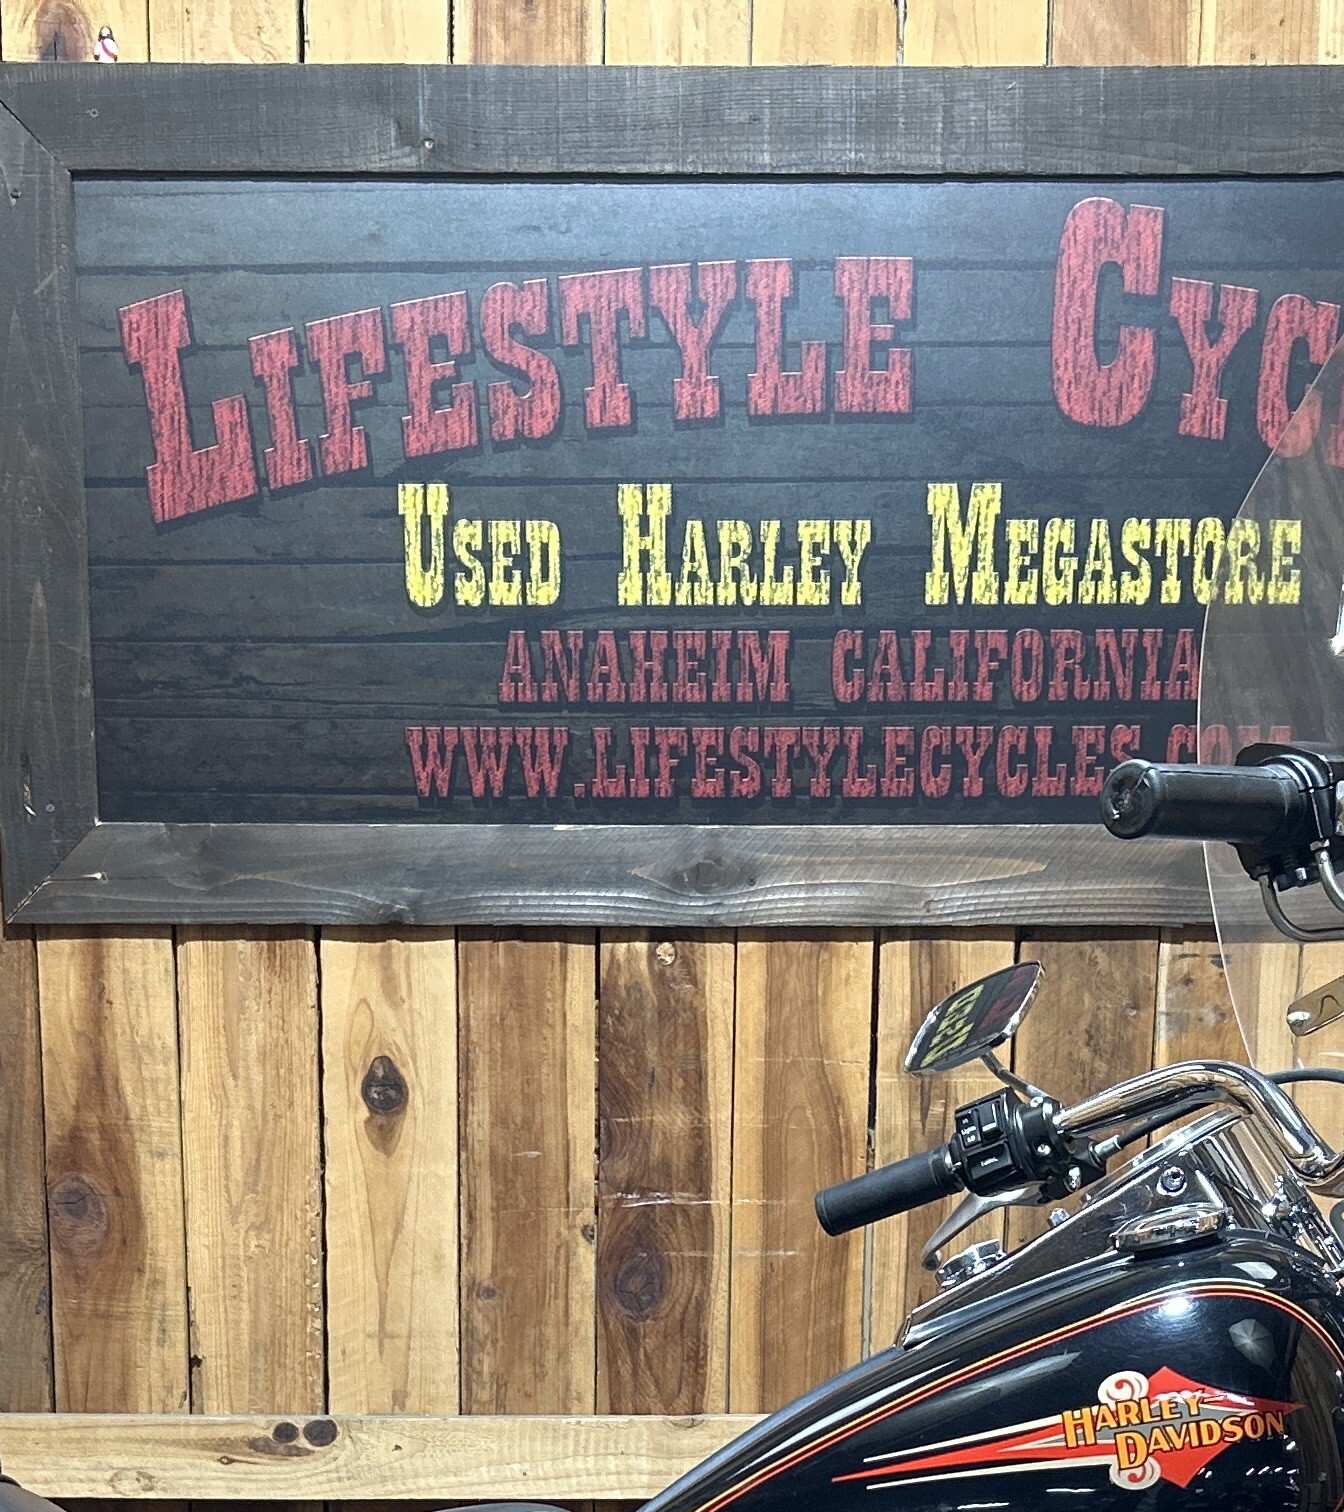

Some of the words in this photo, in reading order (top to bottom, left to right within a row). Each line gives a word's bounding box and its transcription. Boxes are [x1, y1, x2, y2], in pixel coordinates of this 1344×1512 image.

[119, 256, 914, 523] LIFESTYLE
[398, 483, 562, 607] USED
[617, 483, 871, 607] HARLEY
[925, 483, 1302, 606] MEGASTORE
[499, 630, 789, 702] ANAHEIM
[832, 629, 1199, 701] CALIFORNIA
[406, 725, 1291, 798] WWW.LIFESTYLECYCLESCO
[1115, 1411, 1285, 1470] DAVIDSON
